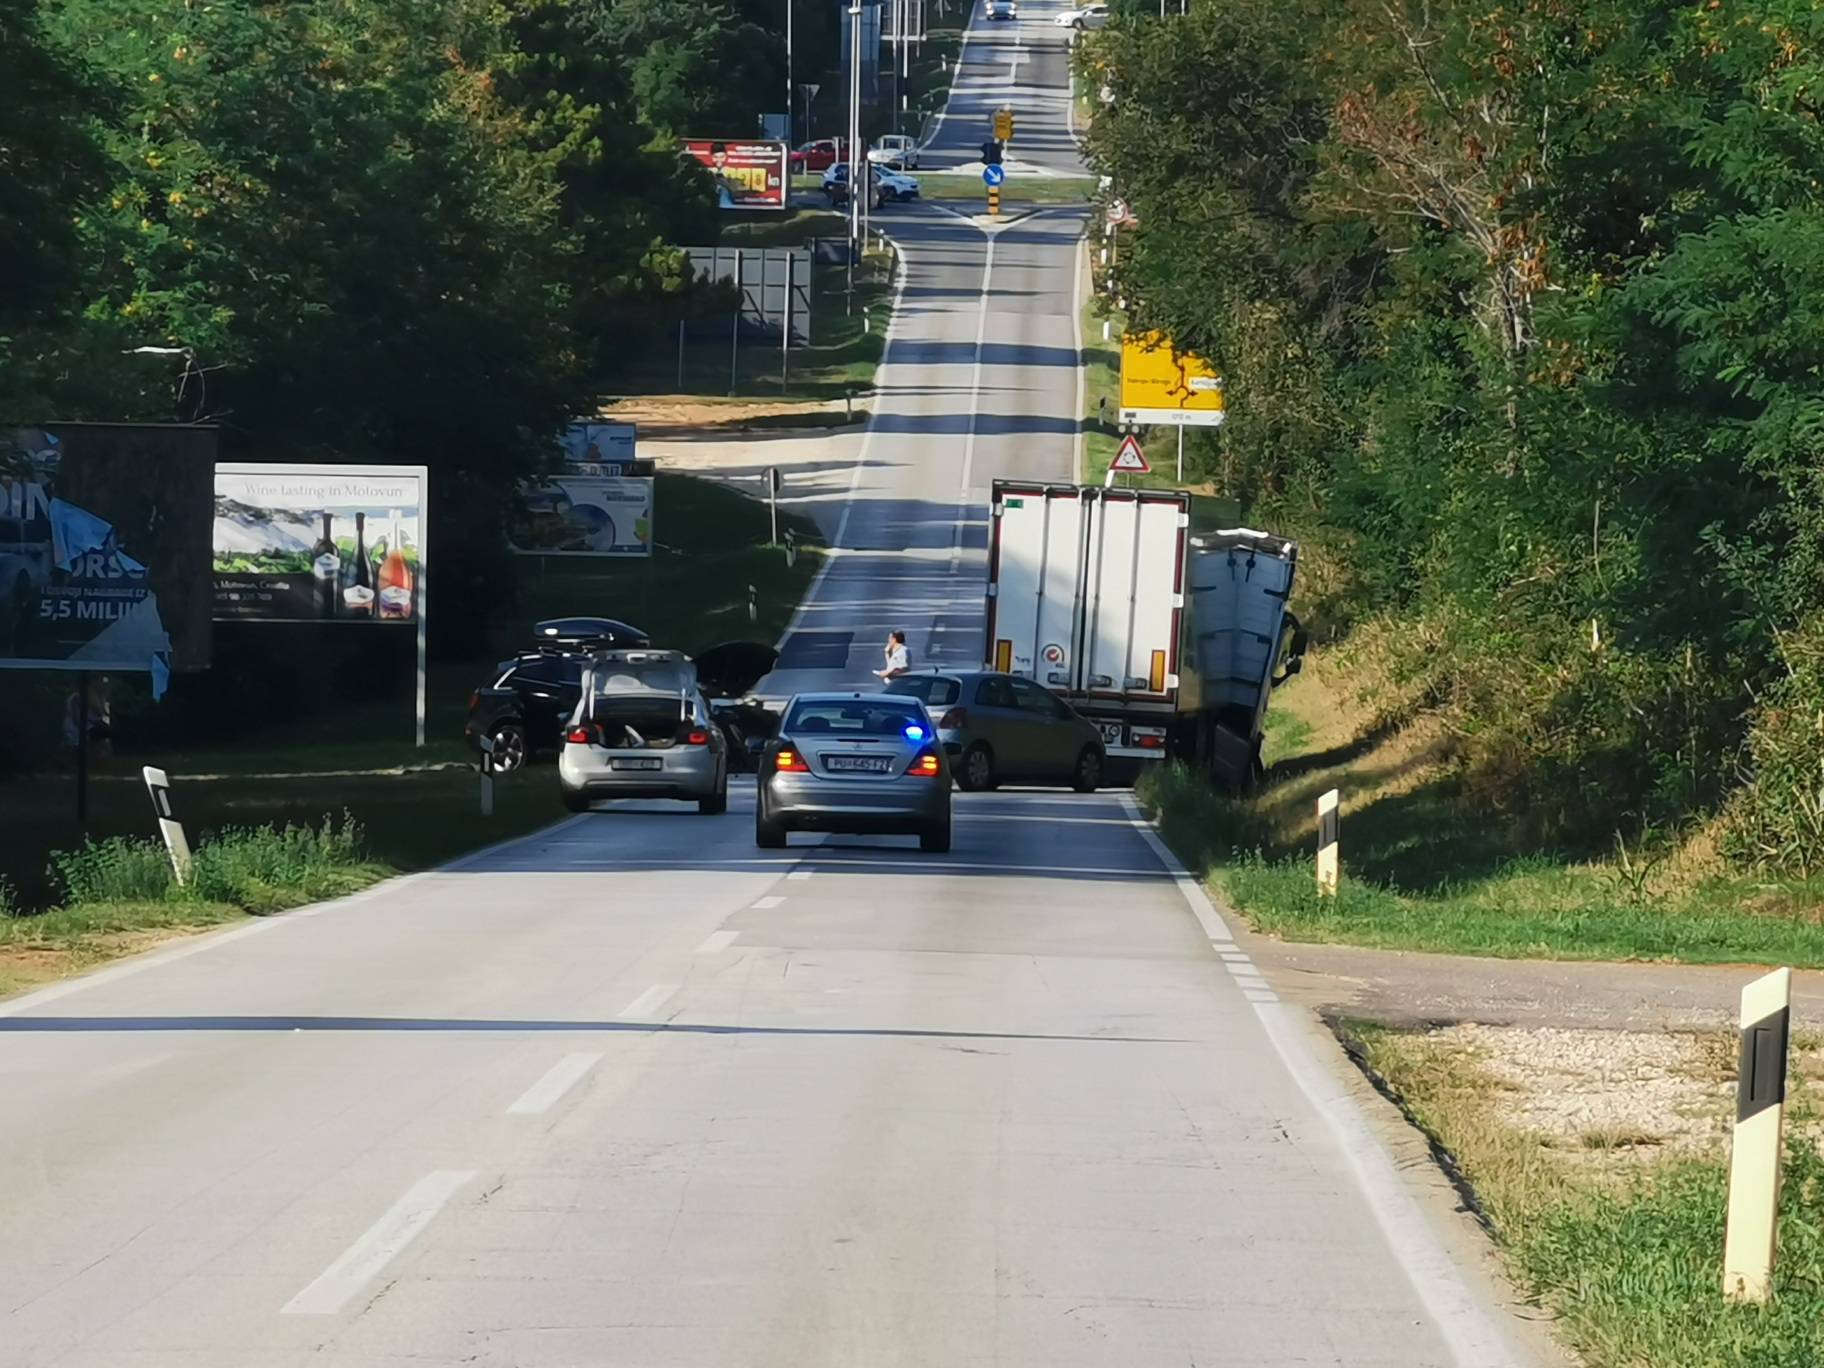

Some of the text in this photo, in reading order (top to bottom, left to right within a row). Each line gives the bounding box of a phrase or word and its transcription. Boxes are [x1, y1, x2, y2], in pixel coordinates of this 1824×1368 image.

[245, 482, 403, 499] Wine tasting in Motovun
[40, 599, 71, 621] 5,5
